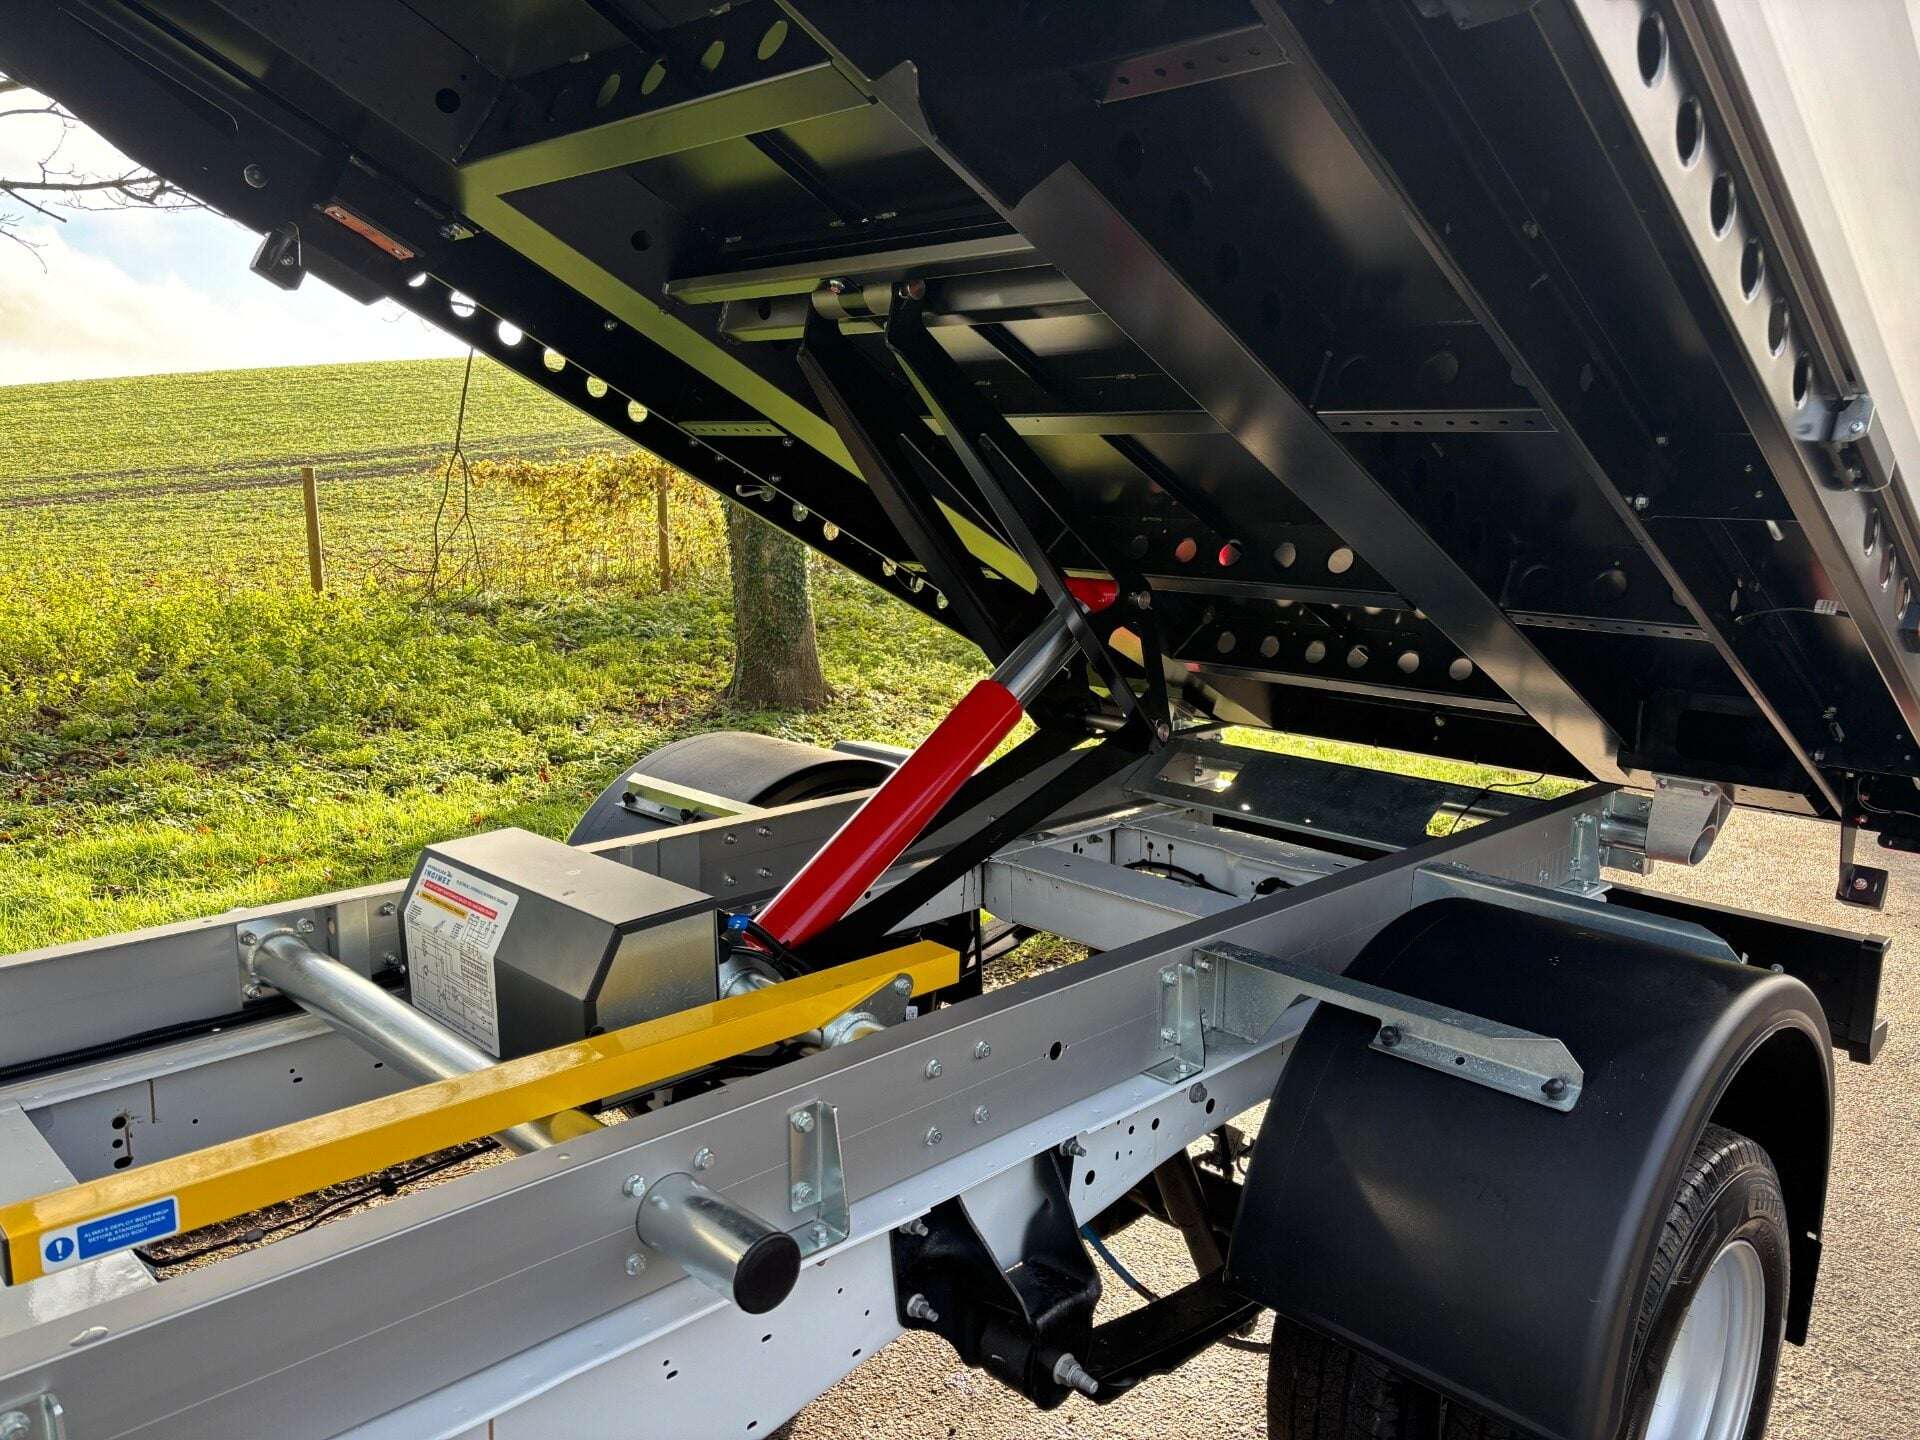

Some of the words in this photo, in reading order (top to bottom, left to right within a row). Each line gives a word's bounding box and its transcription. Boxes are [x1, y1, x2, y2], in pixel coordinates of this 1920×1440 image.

[84, 1226, 108, 1238] ALWAYS
[110, 1219, 133, 1230] DEPLOY
[135, 1214, 151, 1223] BODY
[88, 1232, 113, 1243] BEFORE
[114, 1222, 144, 1234] STANDING
[145, 1215, 165, 1225] UNDER
[108, 1232, 130, 1242] RAISED
[131, 1227, 148, 1236] BODY
